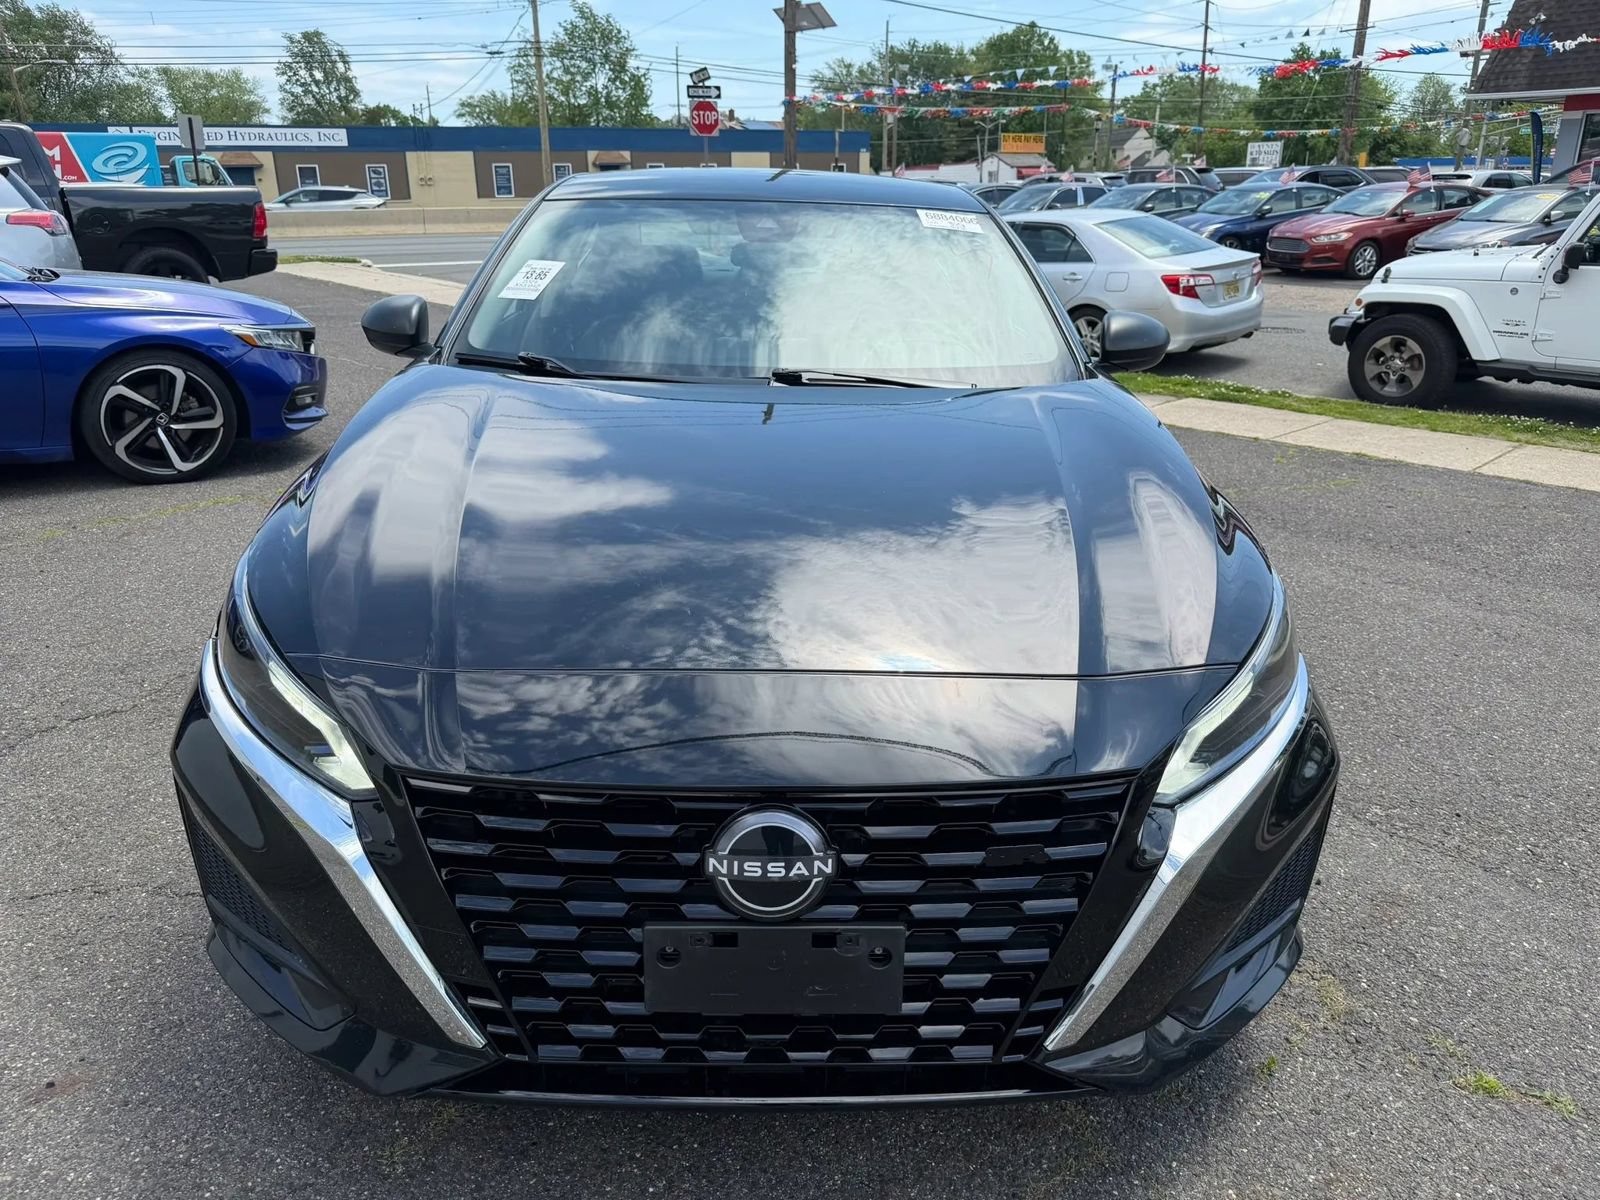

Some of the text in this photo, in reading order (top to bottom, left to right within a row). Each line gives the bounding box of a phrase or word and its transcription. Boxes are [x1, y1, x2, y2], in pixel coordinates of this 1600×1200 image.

[692, 111, 718, 125] STOP
[227, 130, 313, 143] HYDRAULICS,
[317, 131, 343, 143] INC.
[1002, 134, 1044, 144] BUY HERE PAY HERE
[708, 857, 832, 878] NISSAN
